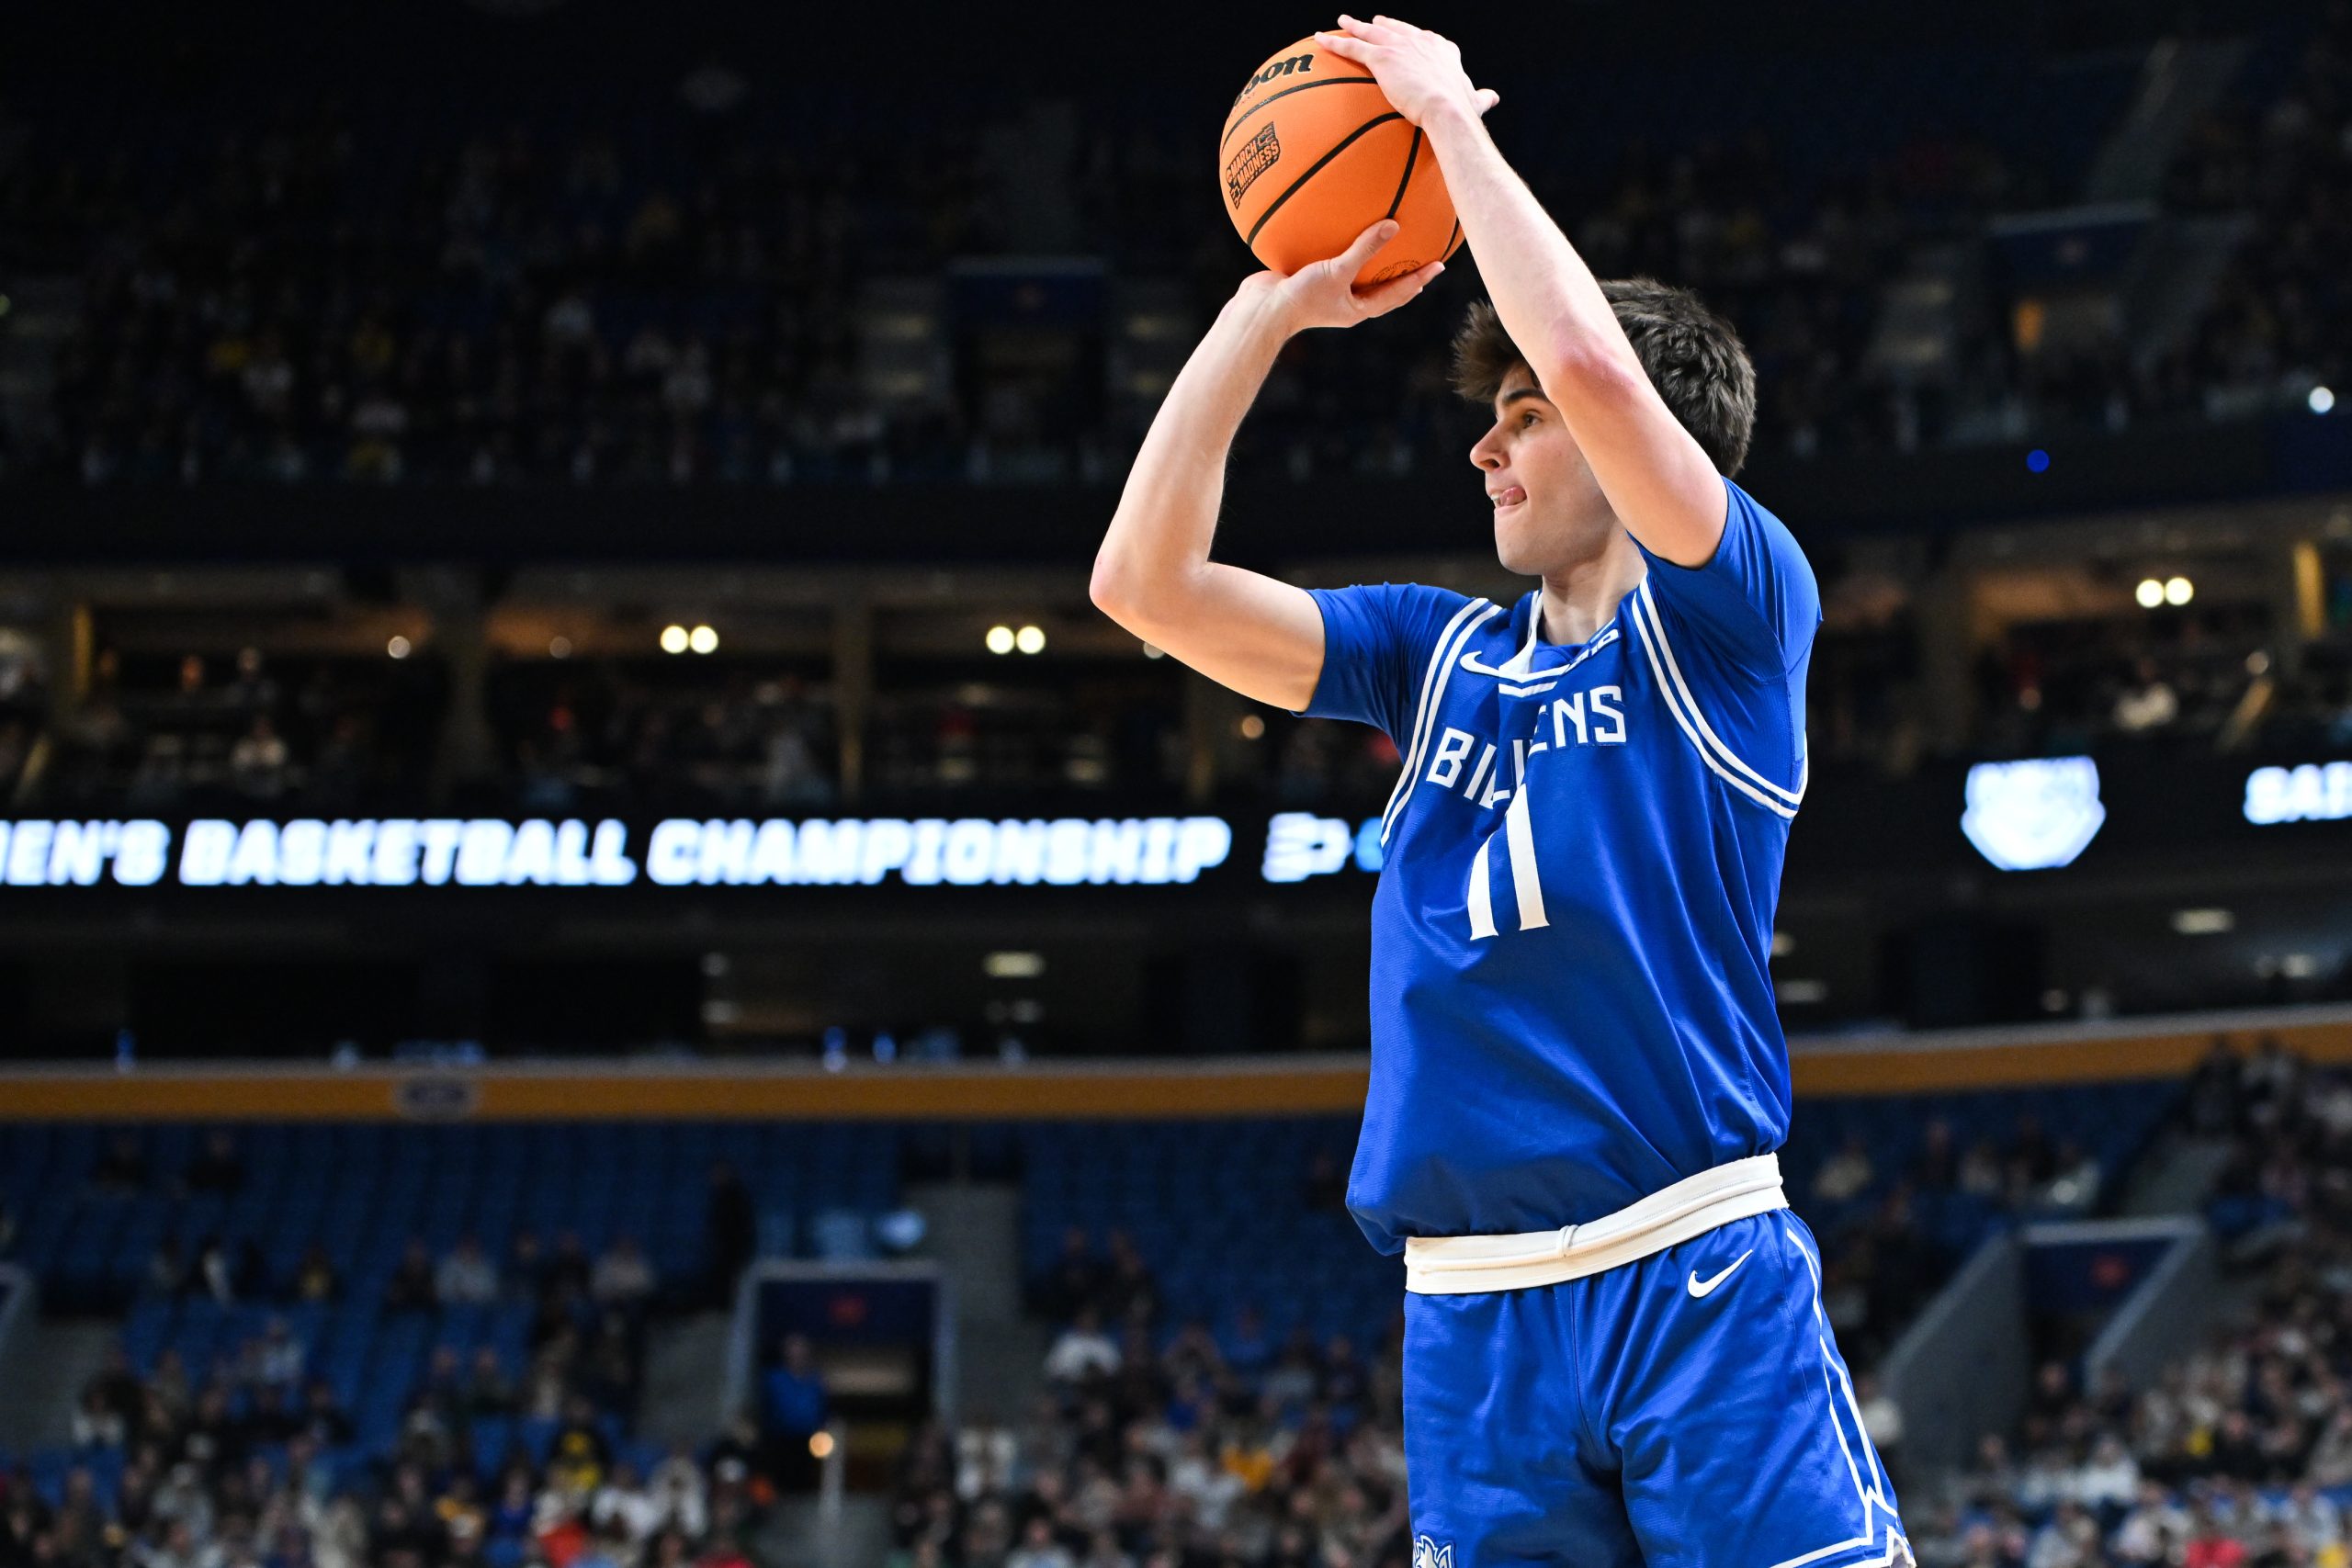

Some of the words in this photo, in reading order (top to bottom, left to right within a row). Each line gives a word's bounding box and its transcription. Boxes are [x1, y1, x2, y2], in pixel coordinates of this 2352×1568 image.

[1229, 140, 1259, 176] MARCH
[1236, 141, 1281, 189] MADNESS
[2244, 761, 2352, 825] SAI
[178, 818, 637, 886] BASKETBALL
[646, 817, 1232, 886] CHAMPIONSHIP
[1467, 785, 1551, 942] 11
